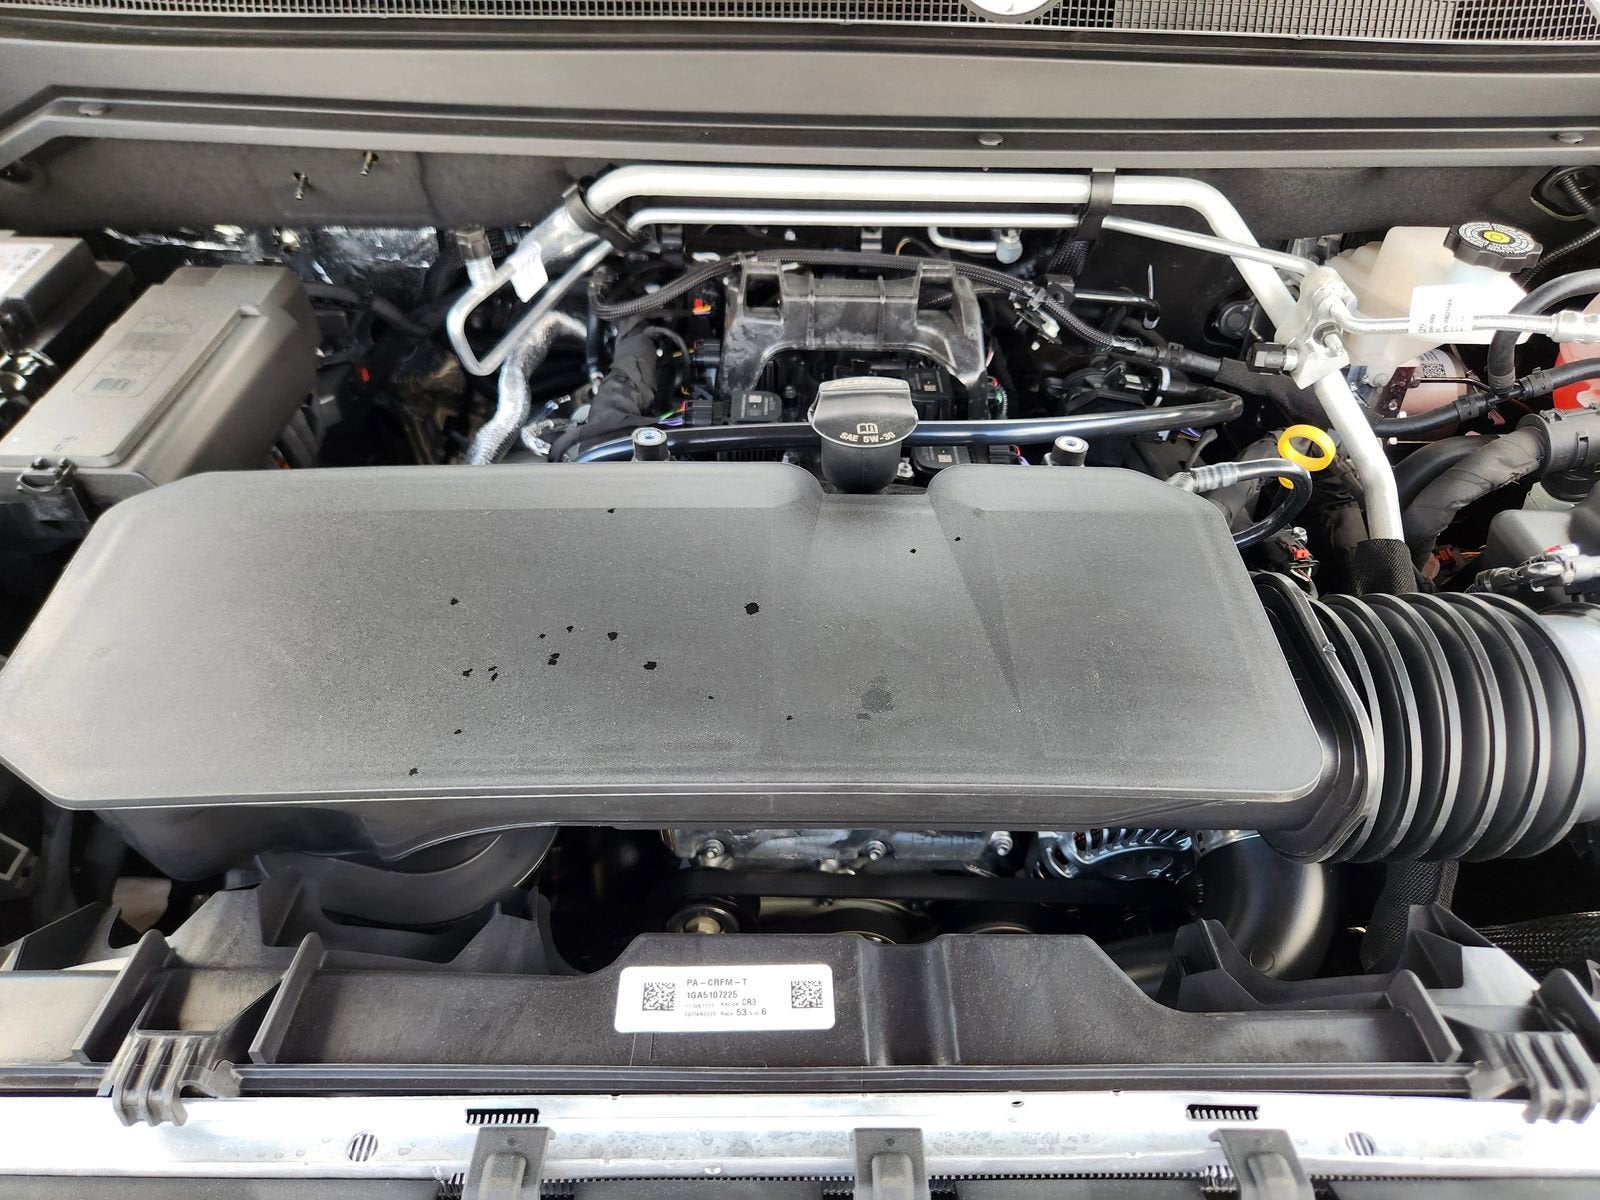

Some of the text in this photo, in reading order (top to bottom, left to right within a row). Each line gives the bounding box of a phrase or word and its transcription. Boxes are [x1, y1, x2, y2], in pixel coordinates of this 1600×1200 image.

[839, 431, 896, 443] SAE 5W-30
[687, 990, 738, 999] 1GA5107225
[741, 997, 757, 1006] CR3
[736, 1008, 748, 1017] 53
[761, 1007, 767, 1016] 6
